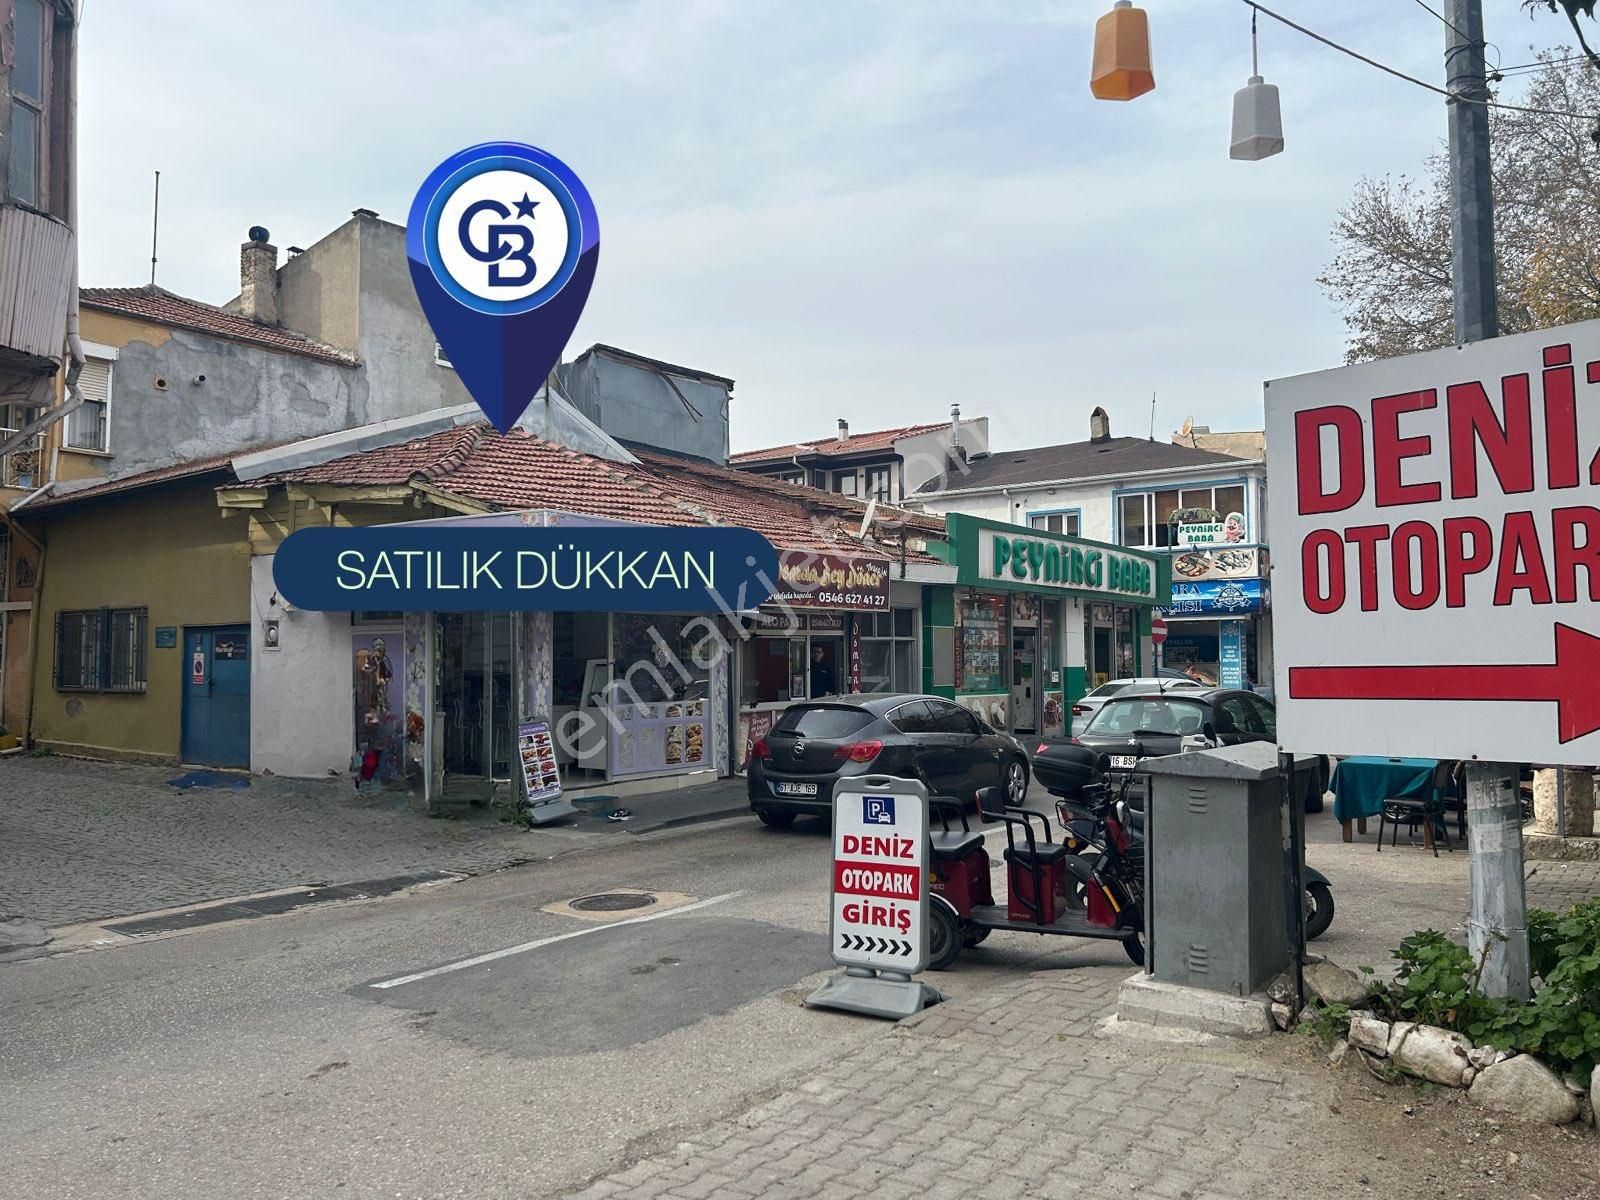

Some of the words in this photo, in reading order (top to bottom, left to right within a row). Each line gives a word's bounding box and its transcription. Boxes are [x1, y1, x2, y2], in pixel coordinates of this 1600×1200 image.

[1295, 343, 1600, 516] DENİ
[1187, 534, 1214, 543] BABA
[1301, 505, 1600, 615] OTOPAR
[1107, 553, 1151, 595] BABA
[819, 592, 843, 604] 0546
[845, 593, 861, 604] 627
[863, 595, 873, 605] 41
[874, 595, 885, 606] 27
[1112, 756, 1120, 765] 16
[842, 832, 914, 859] DENİZ
[841, 868, 913, 895] OTOPARK
[842, 900, 912, 935] GİRİŞ
